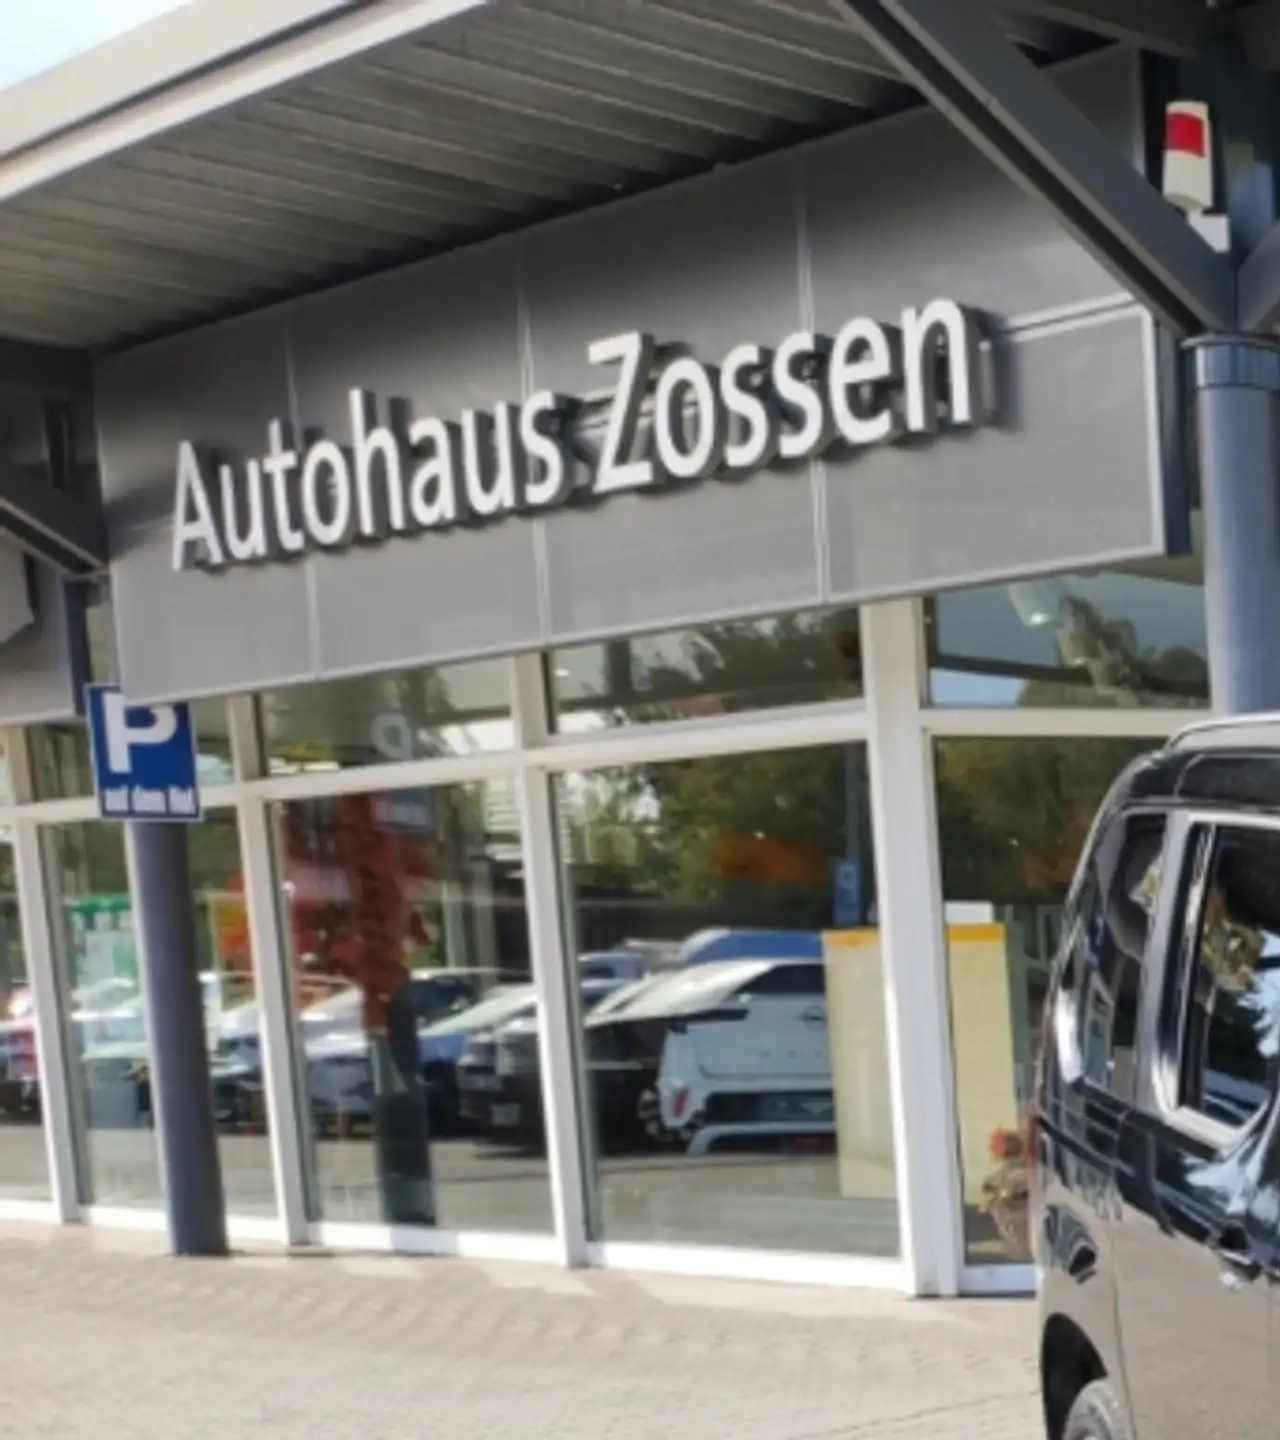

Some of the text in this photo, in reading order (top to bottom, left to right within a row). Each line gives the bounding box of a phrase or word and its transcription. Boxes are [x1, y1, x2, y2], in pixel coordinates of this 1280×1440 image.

[172, 298, 970, 572] Autohaus Zossen
[103, 692, 177, 773] P
